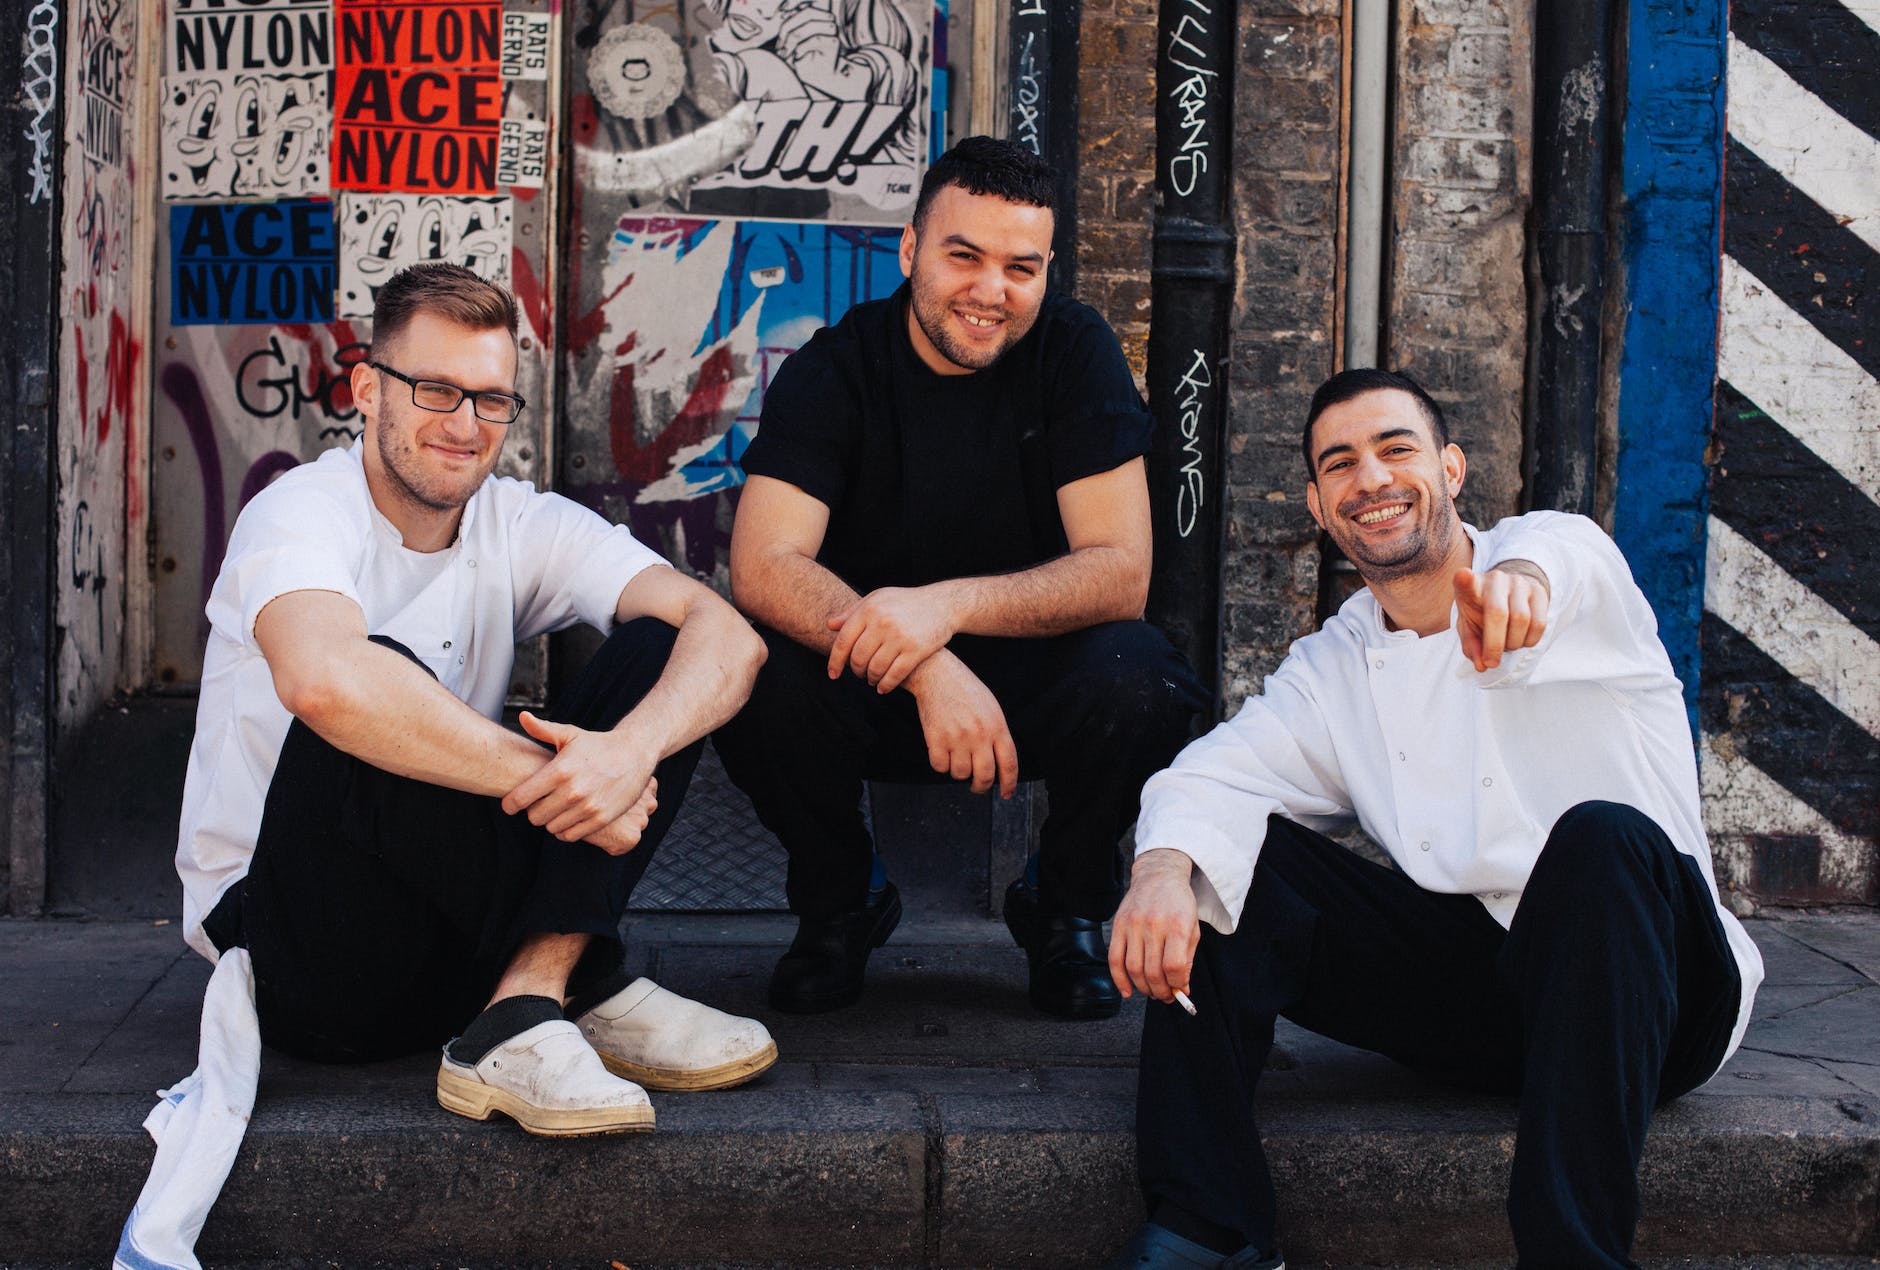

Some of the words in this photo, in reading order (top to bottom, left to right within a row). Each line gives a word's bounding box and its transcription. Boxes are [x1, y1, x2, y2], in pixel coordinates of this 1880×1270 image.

[176, 13, 329, 72] NYLON
[341, 8, 500, 64] NYLON
[526, 21, 548, 69] RATS
[88, 41, 124, 104] ACE
[343, 68, 499, 126] ACE
[86, 94, 122, 168] NYLON
[338, 129, 498, 190] NYLON
[522, 130, 545, 177] RATS
[179, 203, 333, 257] ACE
[178, 264, 333, 320] NYLON
